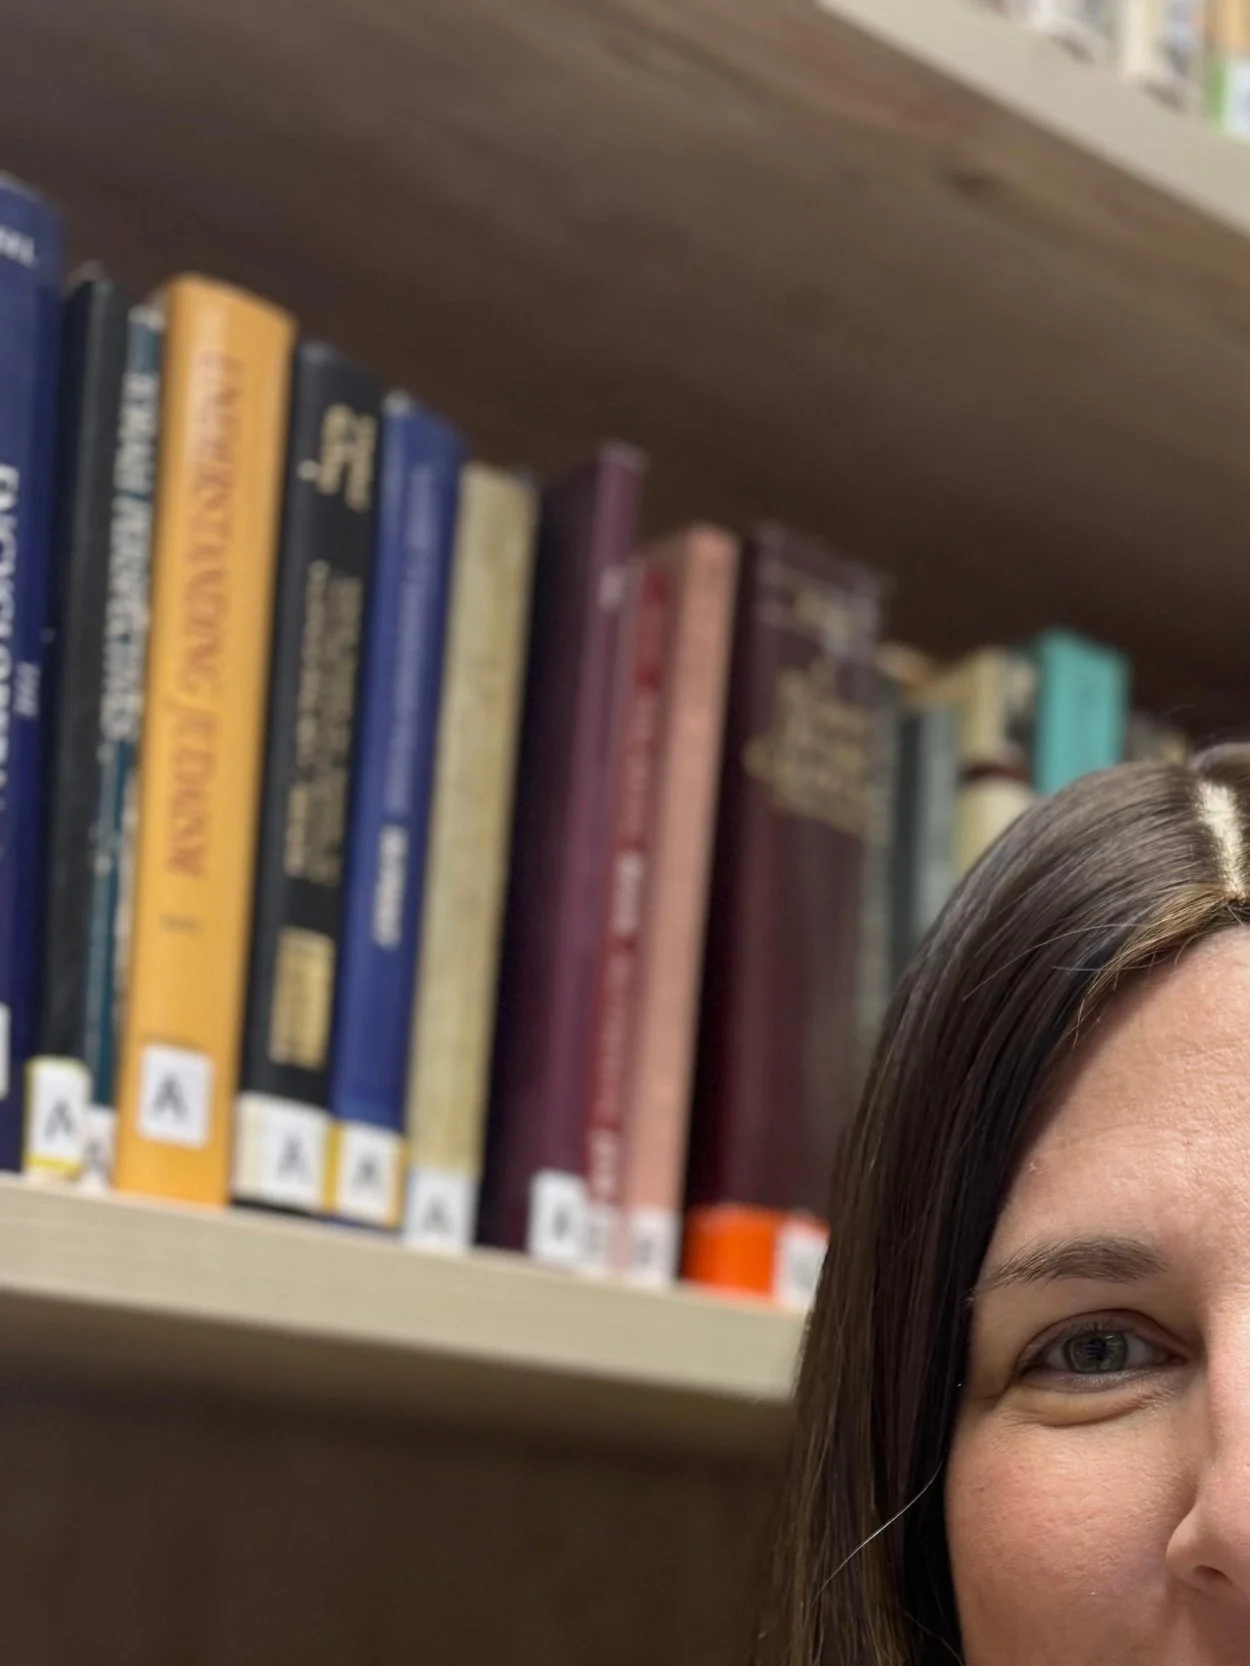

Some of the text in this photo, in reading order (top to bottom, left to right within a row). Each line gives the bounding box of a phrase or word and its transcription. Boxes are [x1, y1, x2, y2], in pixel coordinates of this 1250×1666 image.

[178, 354, 245, 696] UNDERSTANDING
[100, 371, 159, 741] TORAH PERSPECTIVES
[164, 697, 217, 879] JUDAISM
[44, 1098, 76, 1139] A
[151, 1071, 189, 1123] A
[276, 1131, 312, 1183] A
[423, 1197, 455, 1235] A
